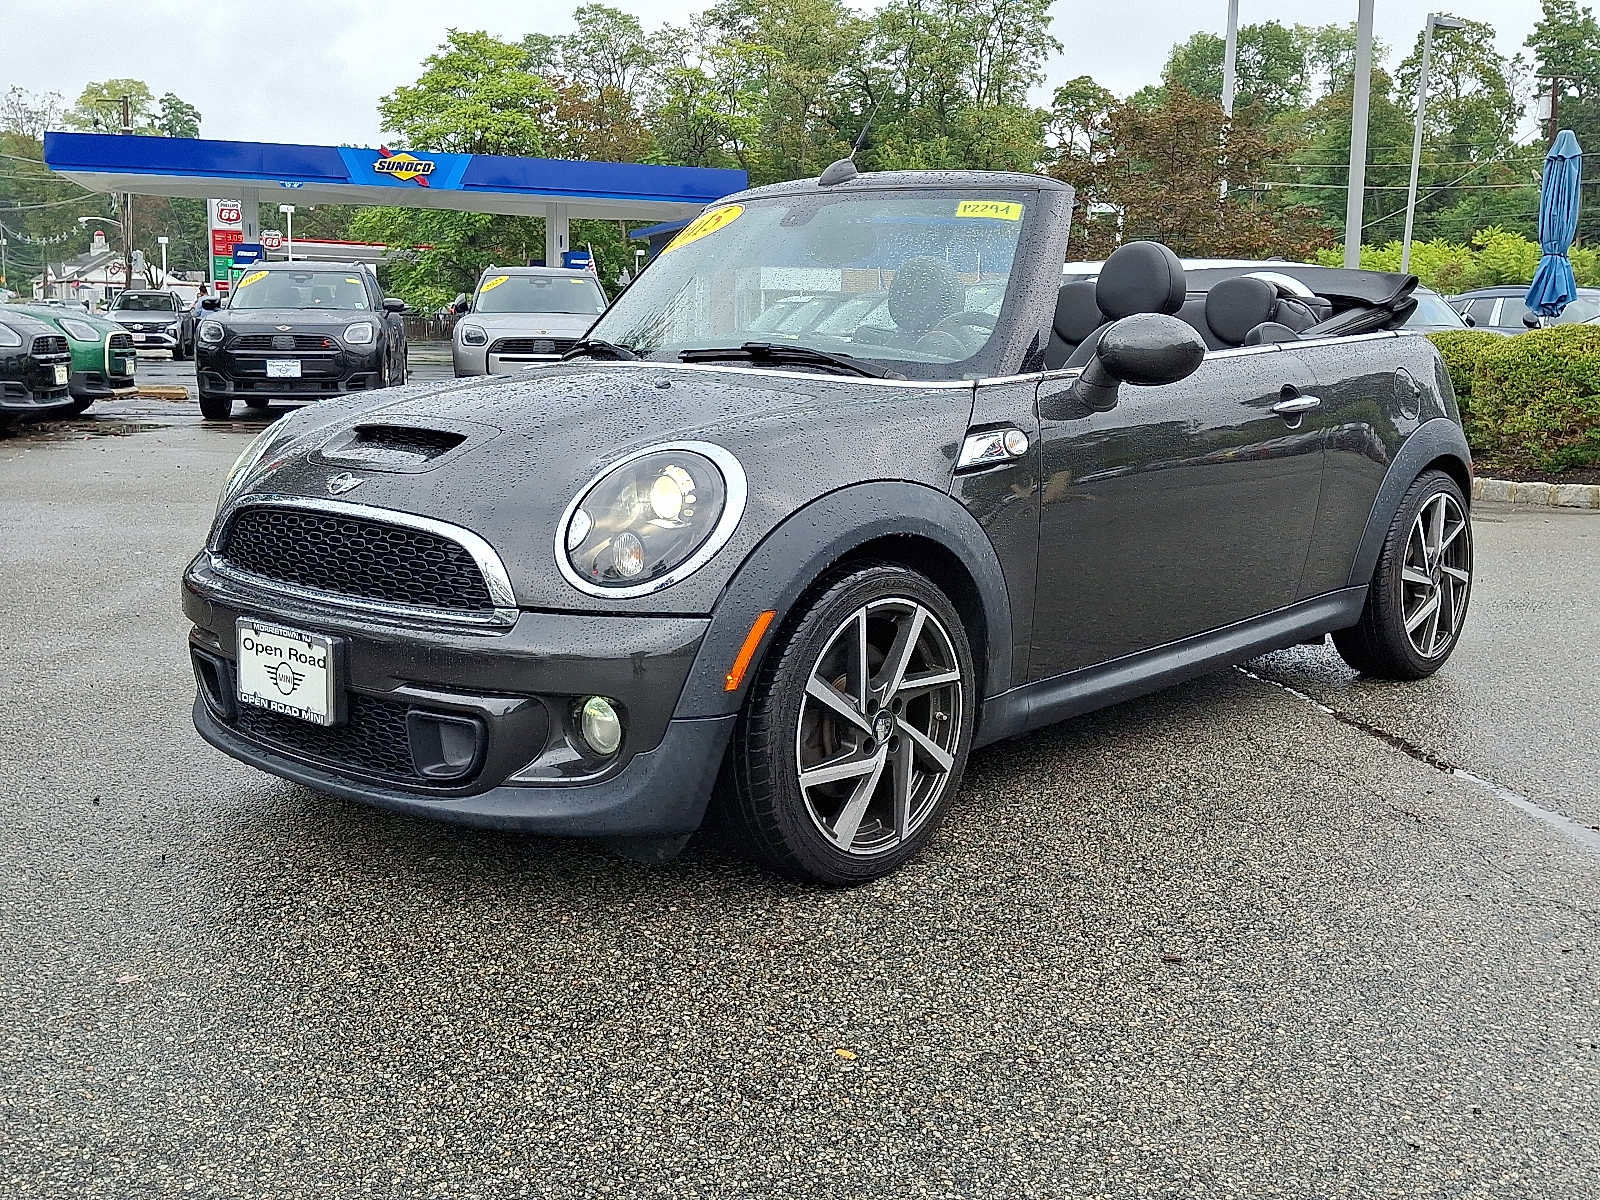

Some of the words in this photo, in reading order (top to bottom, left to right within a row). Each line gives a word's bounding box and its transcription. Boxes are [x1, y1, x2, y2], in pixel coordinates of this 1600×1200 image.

[377, 161, 432, 172] SUNOCO
[221, 210, 238, 220] 66
[243, 637, 283, 658] Open
[288, 647, 327, 669] Road
[278, 672, 293, 685] MINI
[241, 693, 268, 708] OPEN
[270, 701, 299, 717] ROAD
[301, 709, 324, 724] MINI
